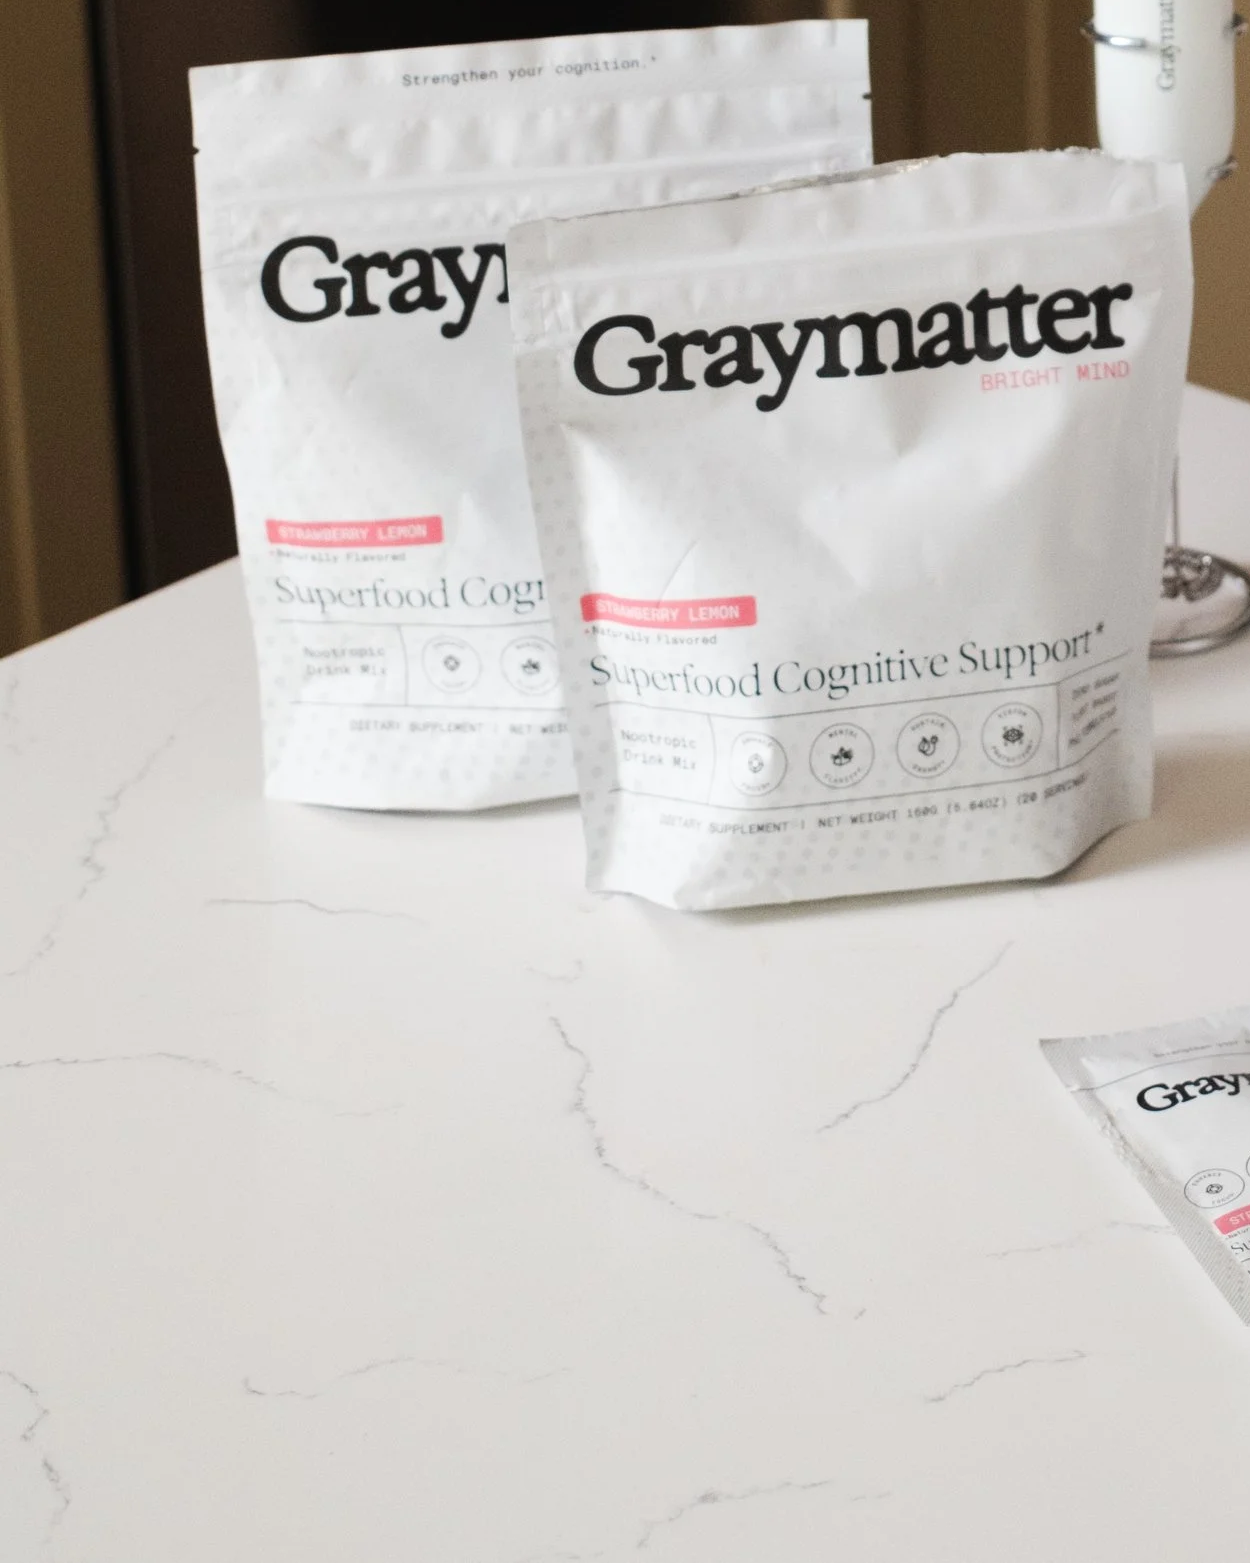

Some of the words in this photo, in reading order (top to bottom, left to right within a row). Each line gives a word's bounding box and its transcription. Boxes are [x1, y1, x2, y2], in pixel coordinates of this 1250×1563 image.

[402, 70, 498, 87] Strengthen
[508, 66, 543, 81] your
[574, 282, 1133, 413] Graymatter
[980, 365, 1061, 392] BRIGHT
[1077, 360, 1131, 383] MIND
[278, 522, 369, 542] STRAWBERRY
[376, 523, 427, 541] LEMON
[275, 575, 451, 614] Superfood
[595, 599, 680, 623] STRAWBERRY
[687, 605, 740, 623] LEMON
[657, 634, 717, 646] Flavored
[589, 654, 760, 700] Superfood
[773, 645, 949, 701] Cognitive
[621, 729, 698, 751] Nootropic
[623, 749, 665, 766] Drink
[672, 755, 698, 771] Mix
[708, 821, 790, 835] SUPPLEMENT
[817, 814, 842, 828] NET
[850, 808, 898, 825] WEIGHT
